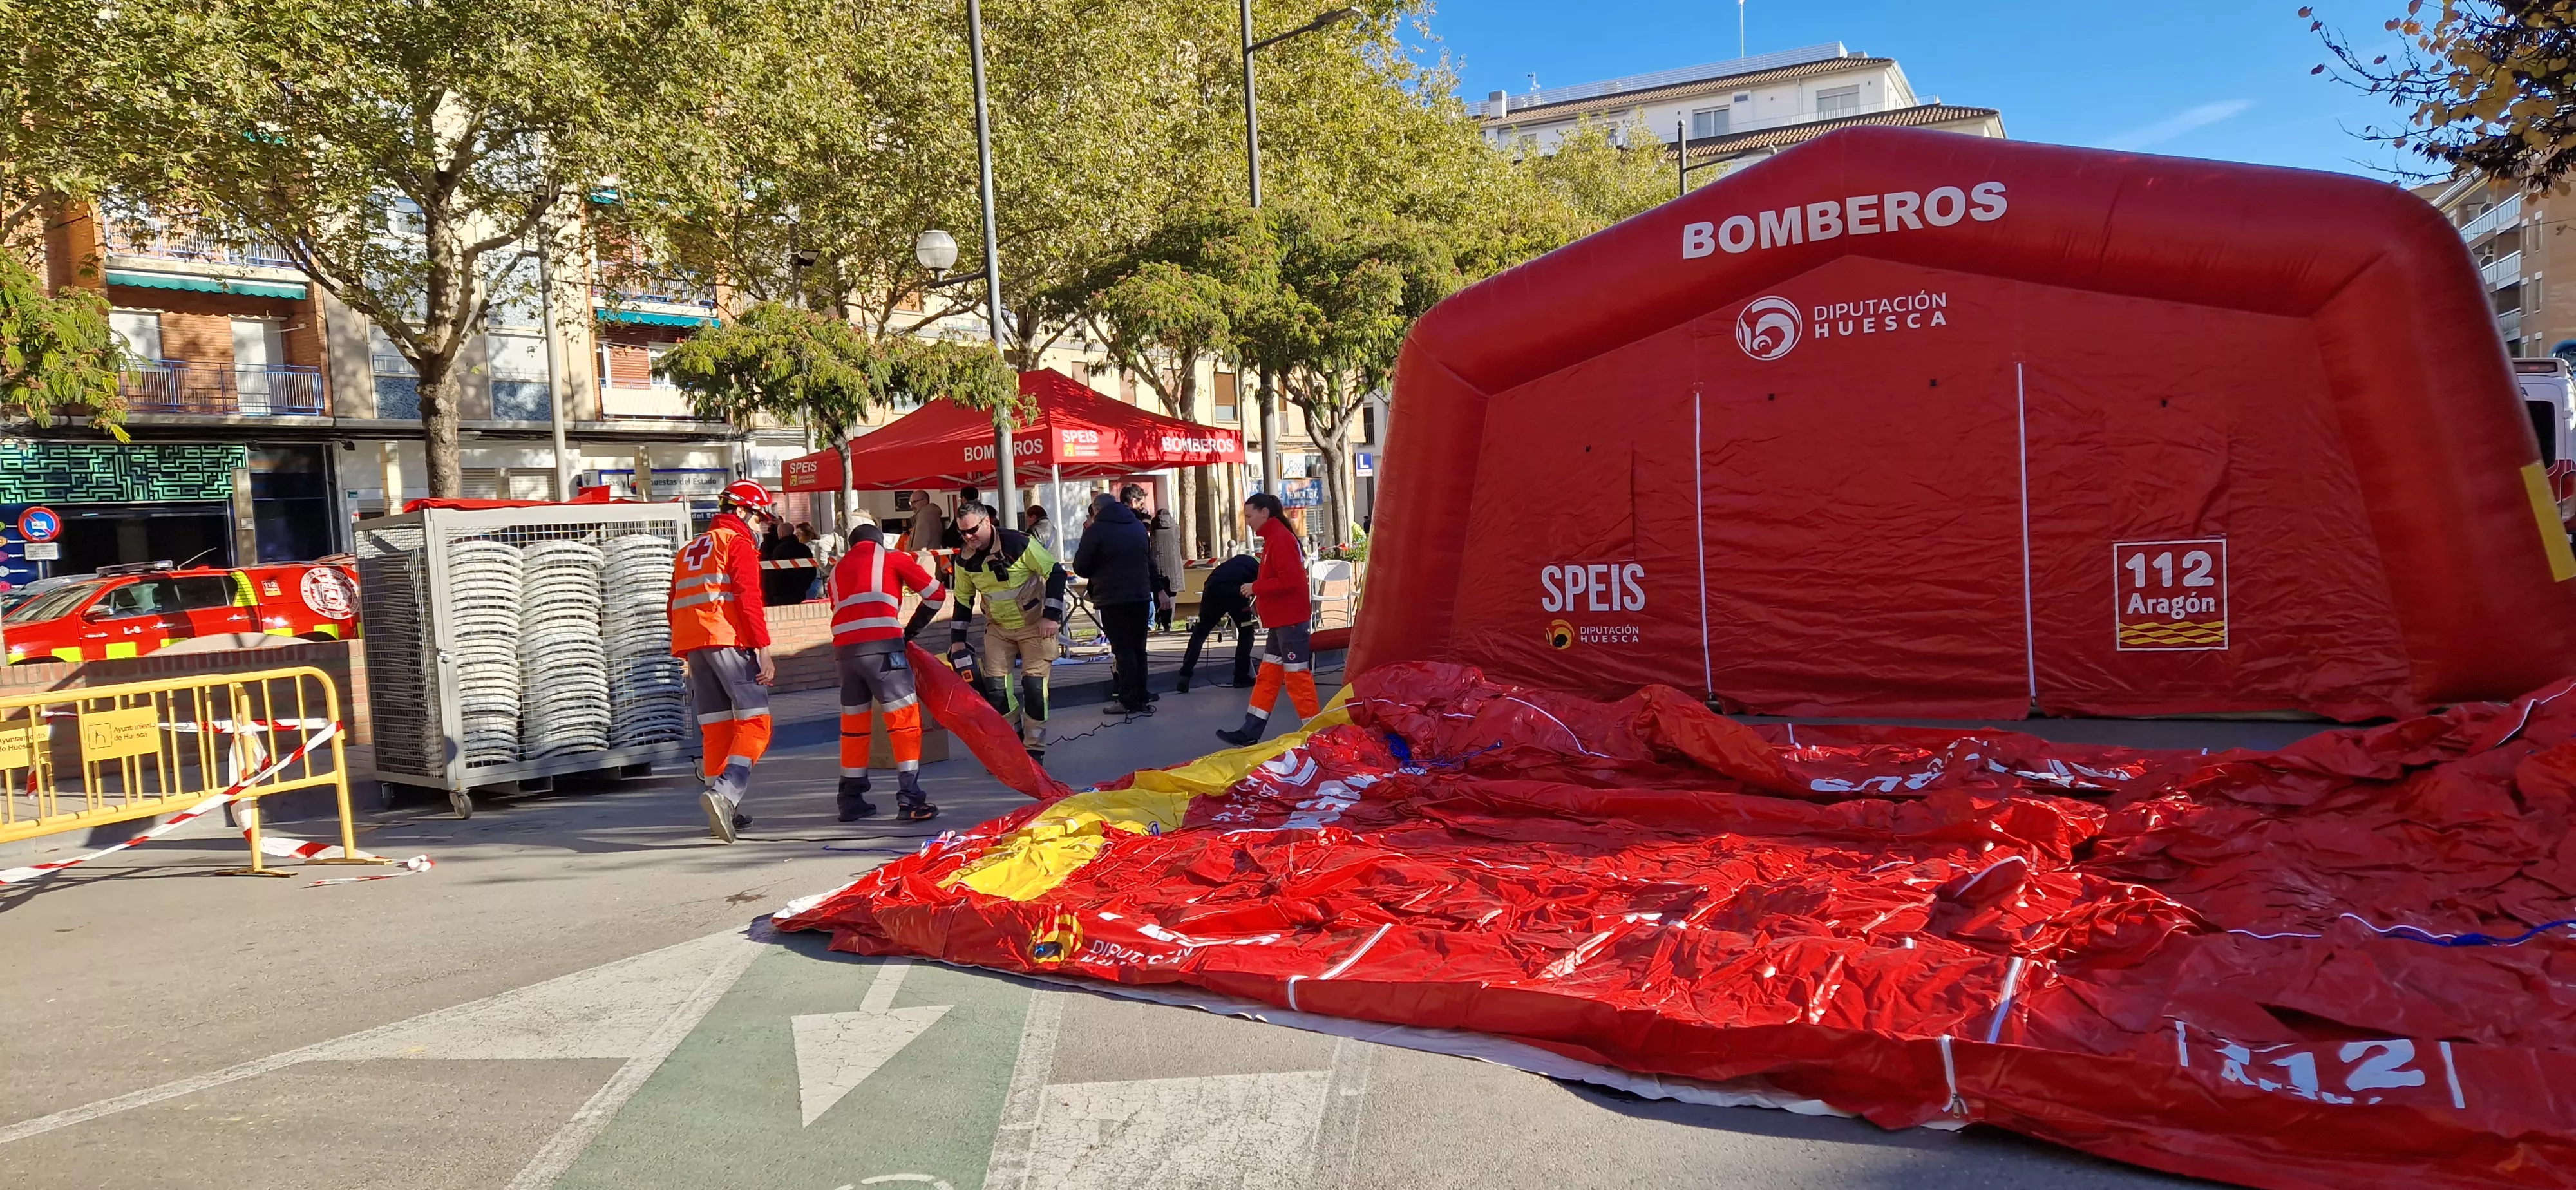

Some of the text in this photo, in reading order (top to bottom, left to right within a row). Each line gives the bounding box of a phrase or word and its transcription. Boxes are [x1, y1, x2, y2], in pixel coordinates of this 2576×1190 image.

[1683, 181, 2008, 259] BOMBEROS
[1814, 290, 1947, 321] DIPUTACIÓN
[1814, 310, 1947, 339] HUESCA
[1062, 430, 1099, 444] SPEIS
[1162, 436, 1235, 453] BOMBEROS
[964, 438, 1043, 462] BOMROS
[1359, 454, 1369, 469] L
[790, 461, 817, 474] SPEIS
[2125, 550, 2215, 588] 112
[1541, 563, 1645, 612] SPEIS
[2126, 591, 2215, 619] Aragón
[1580, 624, 1639, 634] DIPUTACIÓN
[113, 722, 156, 733] Ayuntmiento
